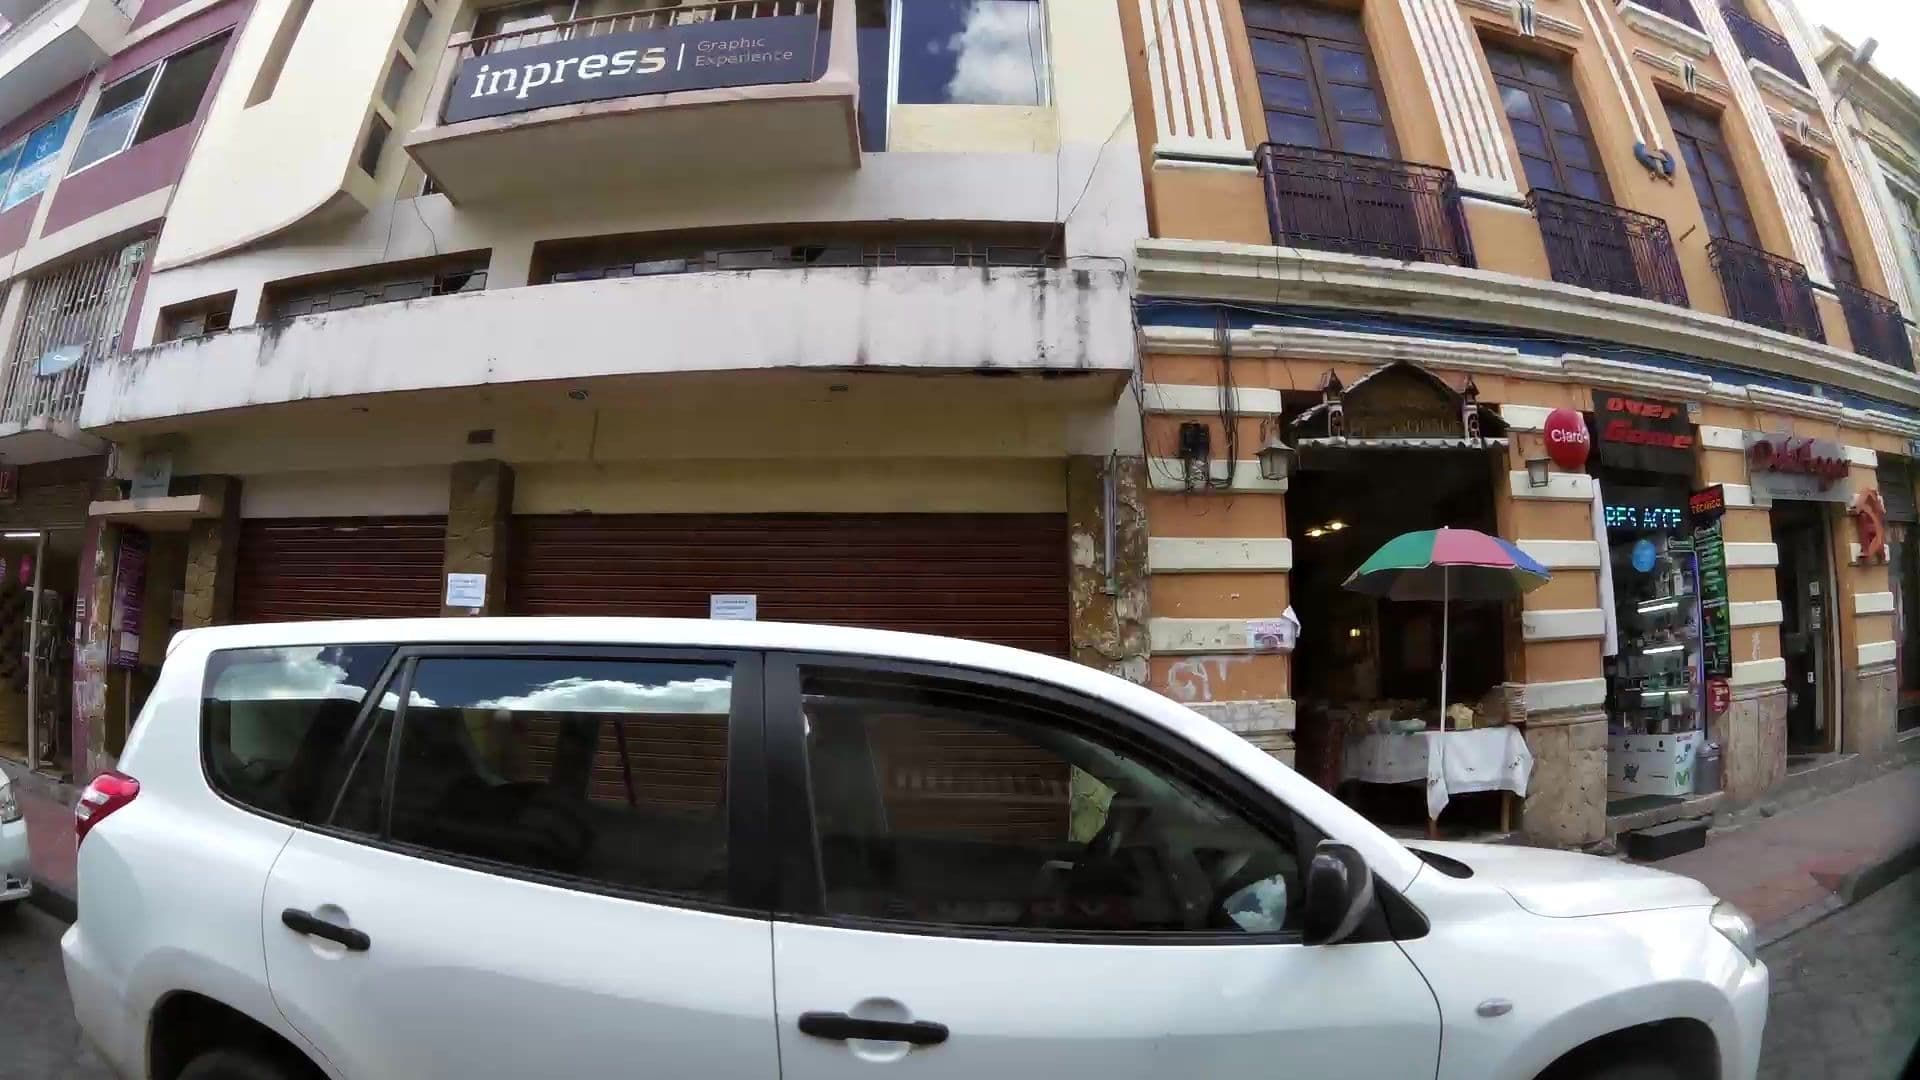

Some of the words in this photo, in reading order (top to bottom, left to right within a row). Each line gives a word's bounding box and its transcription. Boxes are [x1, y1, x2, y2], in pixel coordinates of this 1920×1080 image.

[696, 51, 793, 67] Experience
[470, 47, 666, 99] inpress
[698, 38, 766, 52] Graphic
[1551, 428, 1585, 443] Claro
